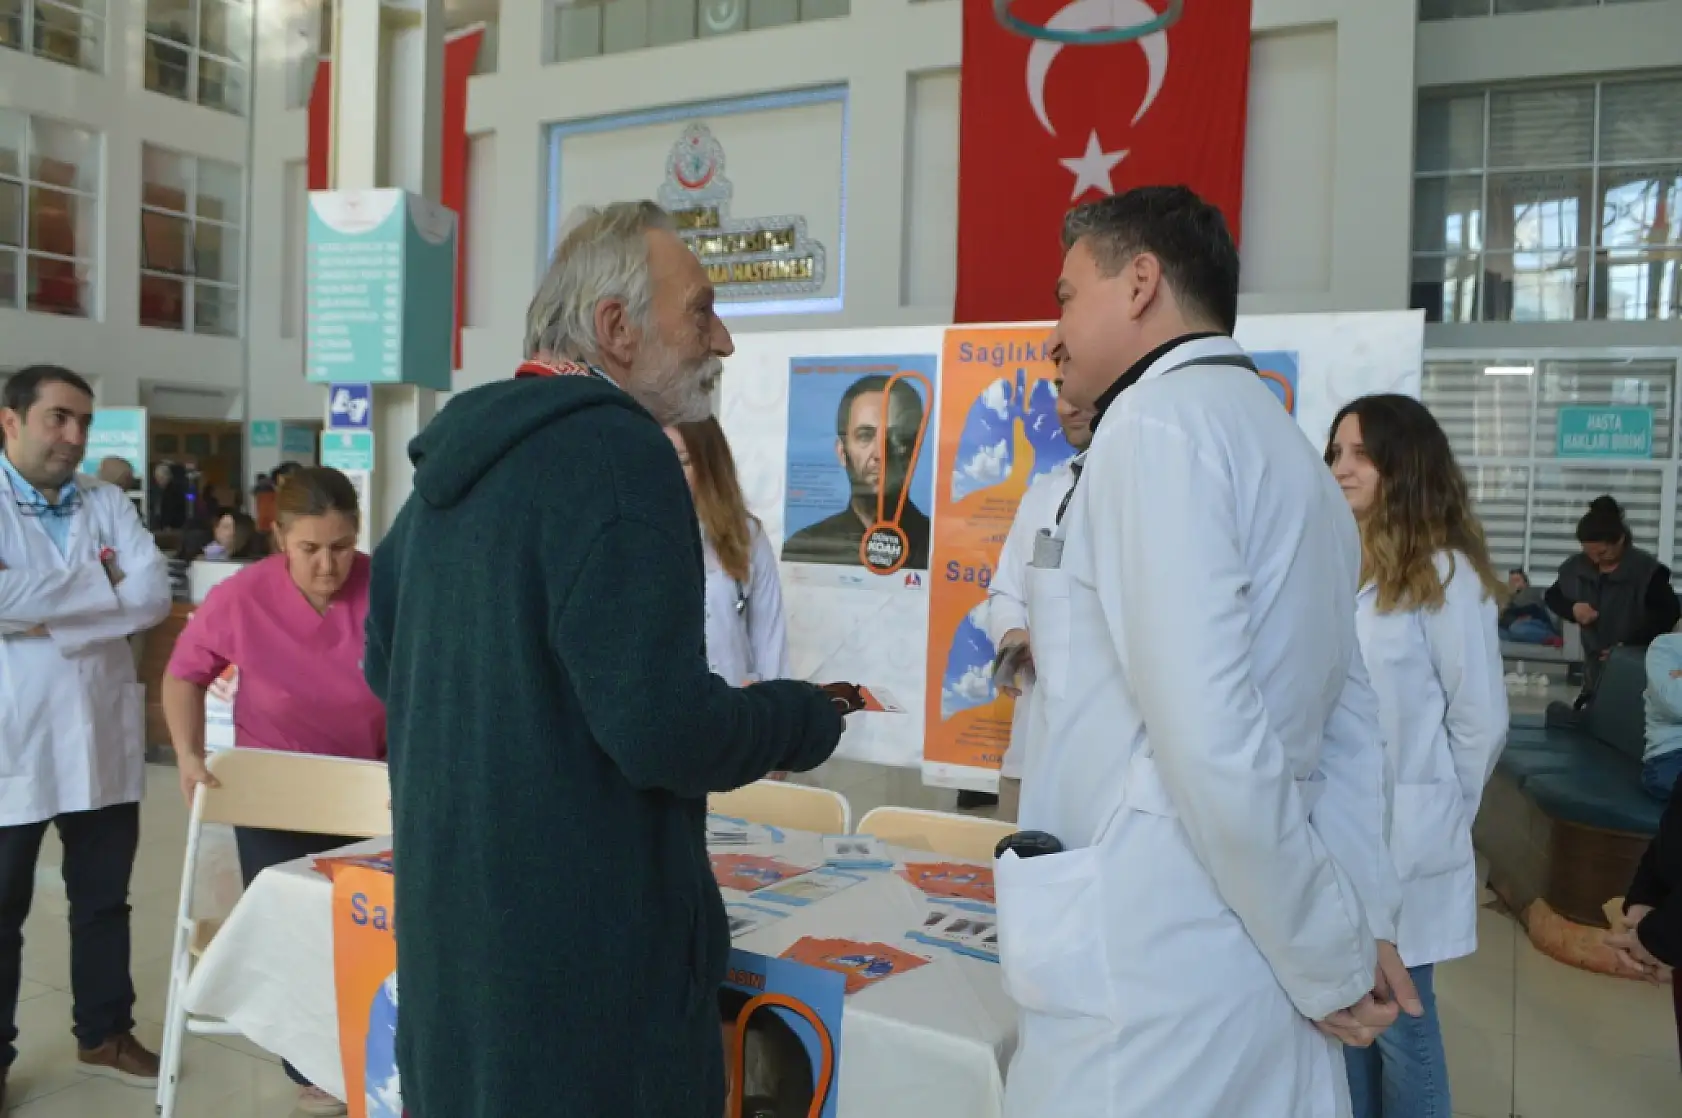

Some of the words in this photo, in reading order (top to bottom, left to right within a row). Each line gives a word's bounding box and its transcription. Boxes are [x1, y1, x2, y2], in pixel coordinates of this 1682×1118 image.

[1587, 412, 1623, 432] HASTA
[946, 560, 994, 588] Sağ
[351, 892, 395, 938] Sa
